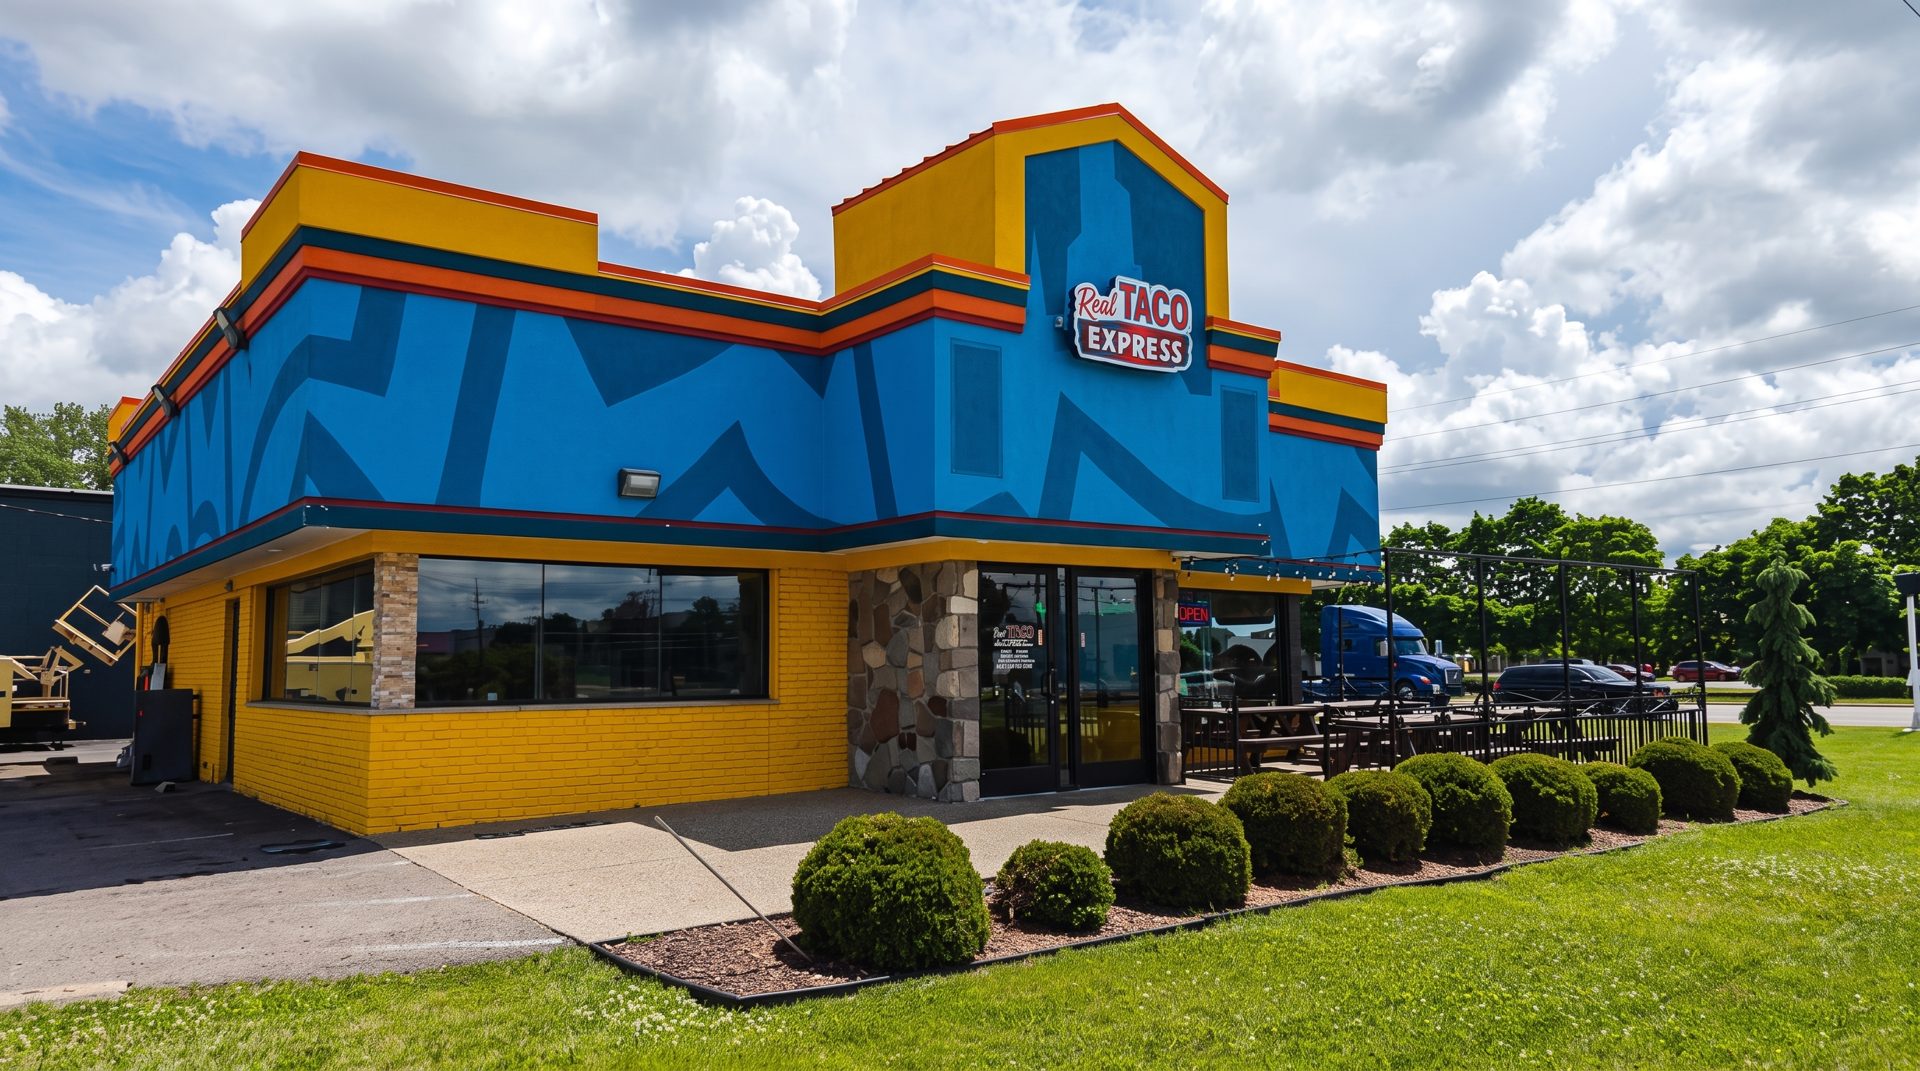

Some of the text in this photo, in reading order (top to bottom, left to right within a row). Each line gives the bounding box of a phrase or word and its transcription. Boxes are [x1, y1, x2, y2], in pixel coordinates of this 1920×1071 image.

[1078, 282, 1188, 331] Real TACO
[1088, 325, 1182, 363] EXPRESS
[1180, 606, 1208, 621] OPEN
